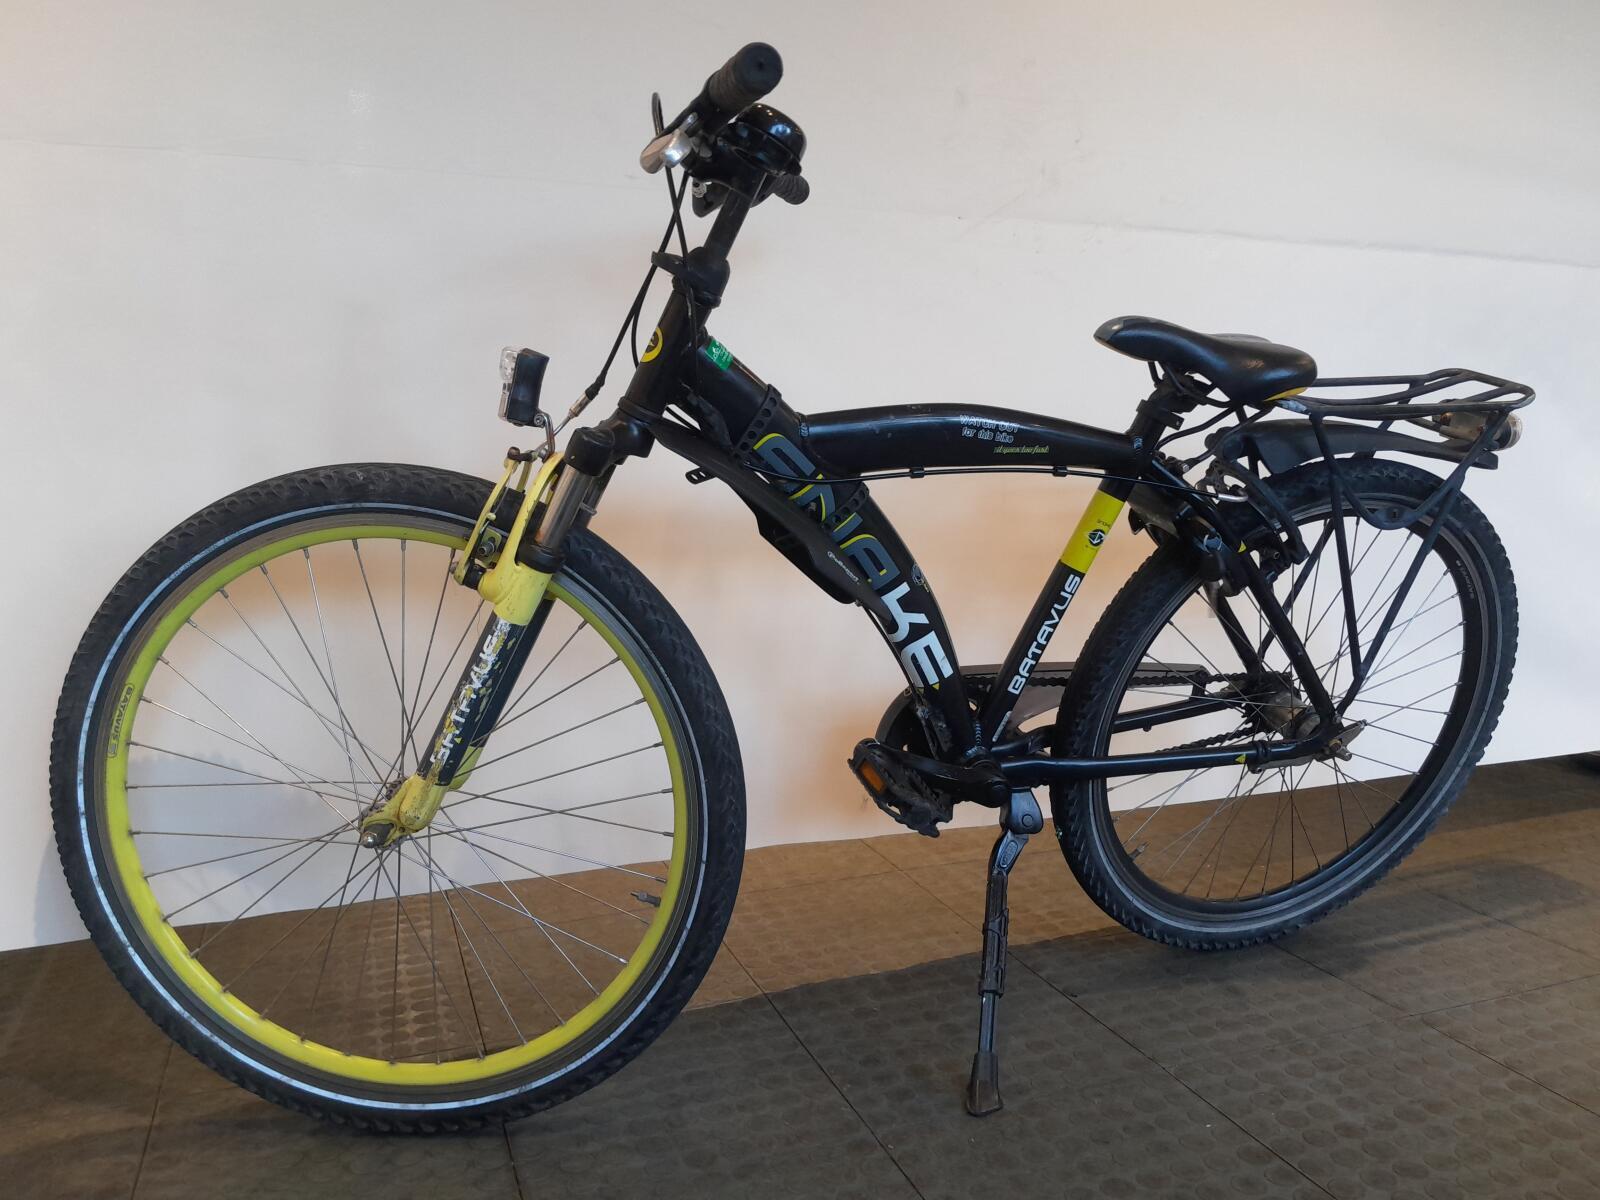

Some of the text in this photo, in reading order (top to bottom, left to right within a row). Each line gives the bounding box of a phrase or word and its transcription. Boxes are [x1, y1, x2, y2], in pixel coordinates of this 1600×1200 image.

[959, 415, 1019, 433] WATCH OUT
[962, 427, 1014, 443] for this bike
[1007, 573, 1081, 695] BATAVUS
[112, 686, 133, 741] BATAVUS
